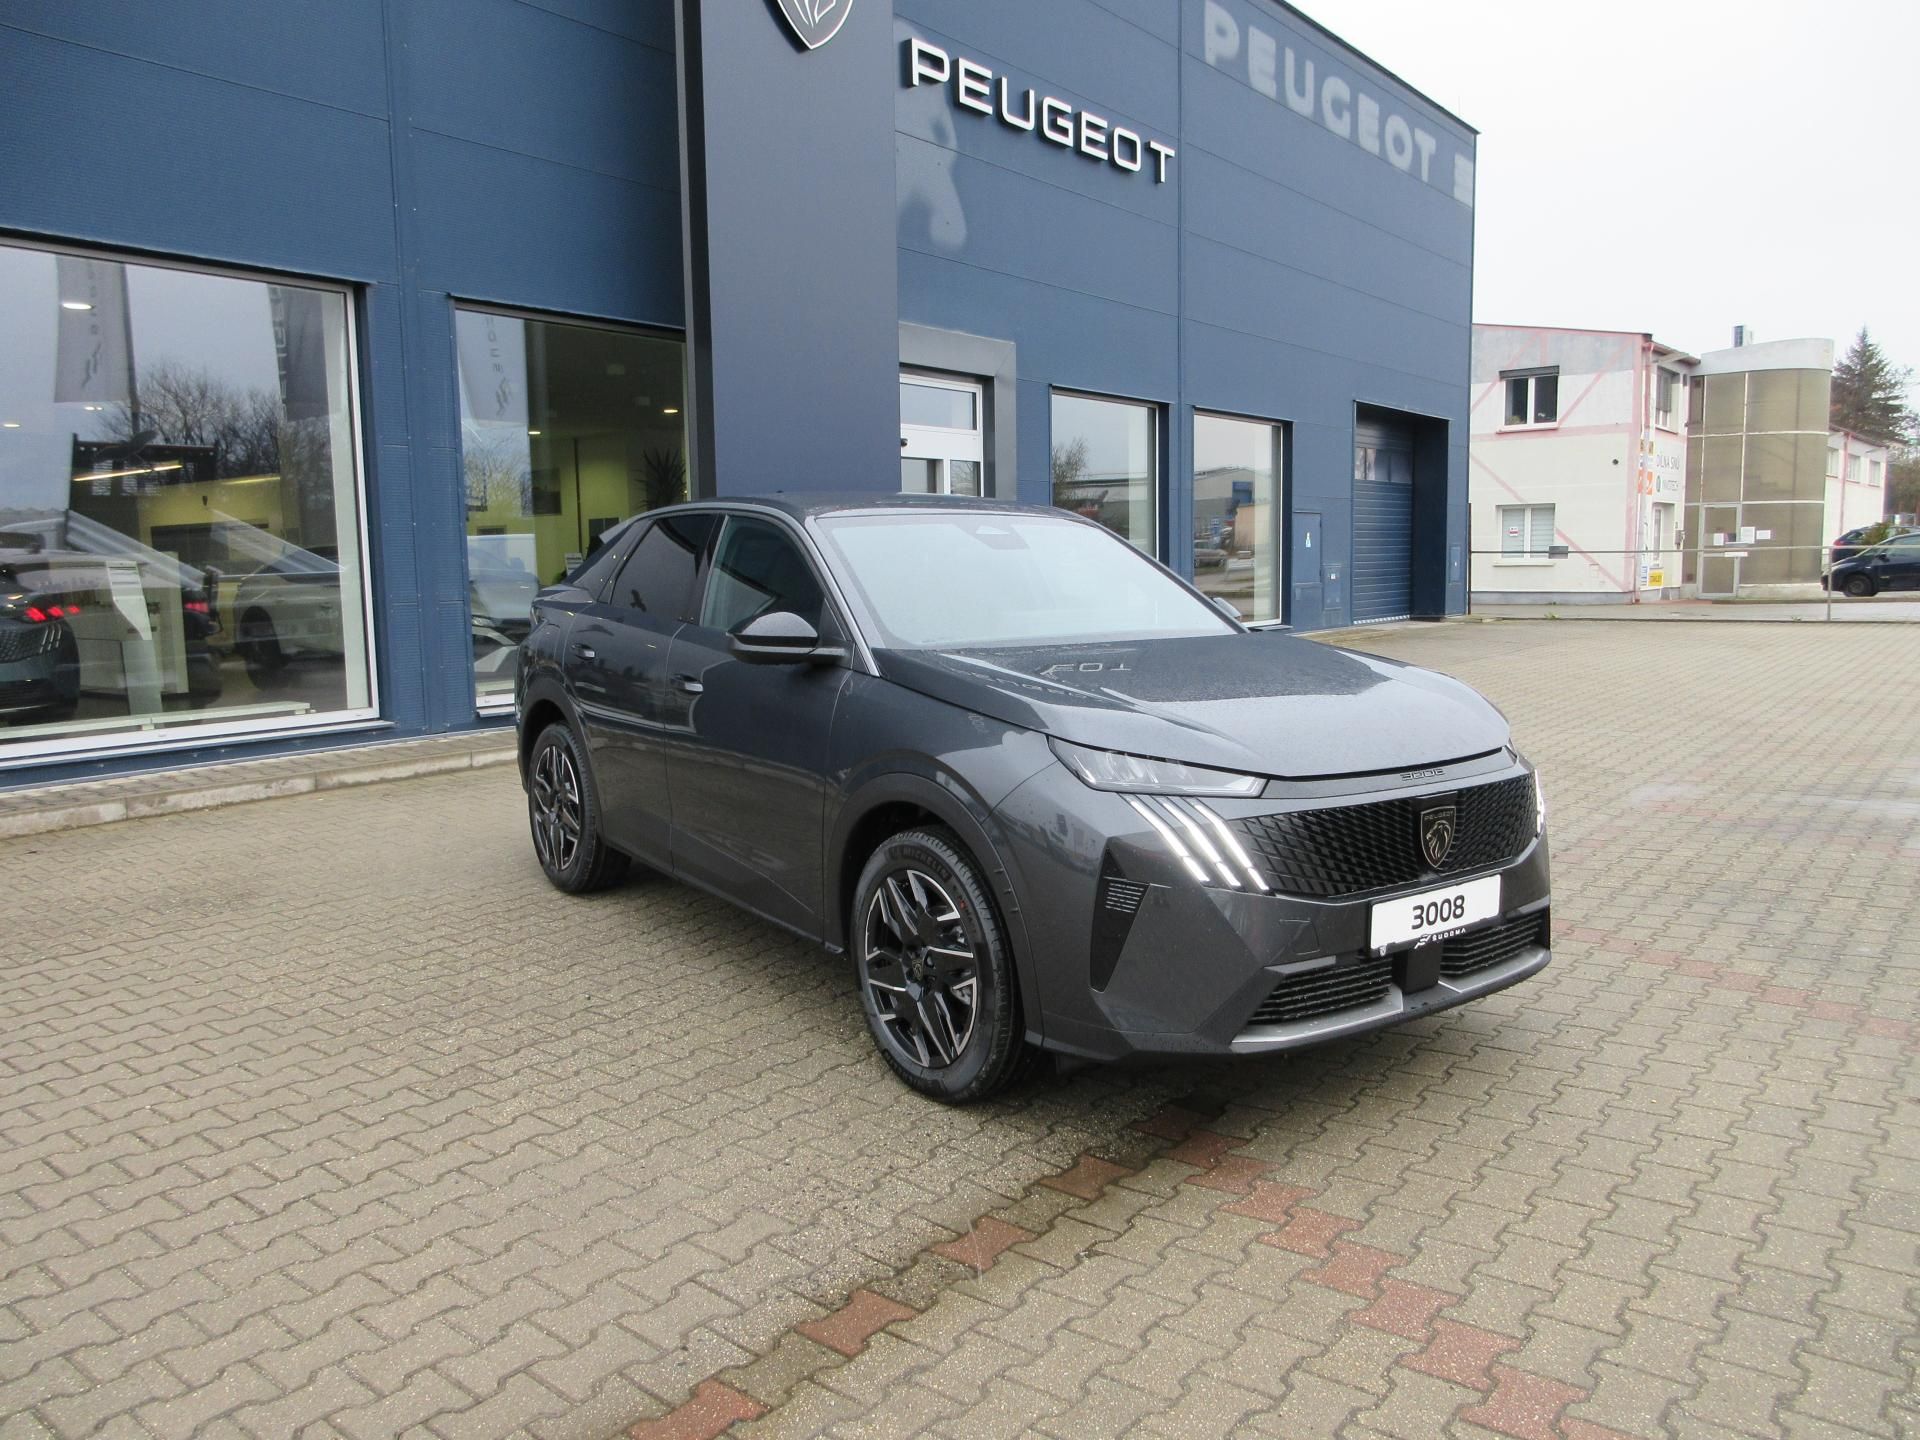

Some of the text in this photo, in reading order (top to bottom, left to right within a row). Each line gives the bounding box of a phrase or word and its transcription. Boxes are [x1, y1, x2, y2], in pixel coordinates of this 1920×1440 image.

[906, 37, 1176, 184] PEUGEOT
[1203, 2, 1437, 183] PEUGEOT
[1411, 894, 1465, 930] 3008
